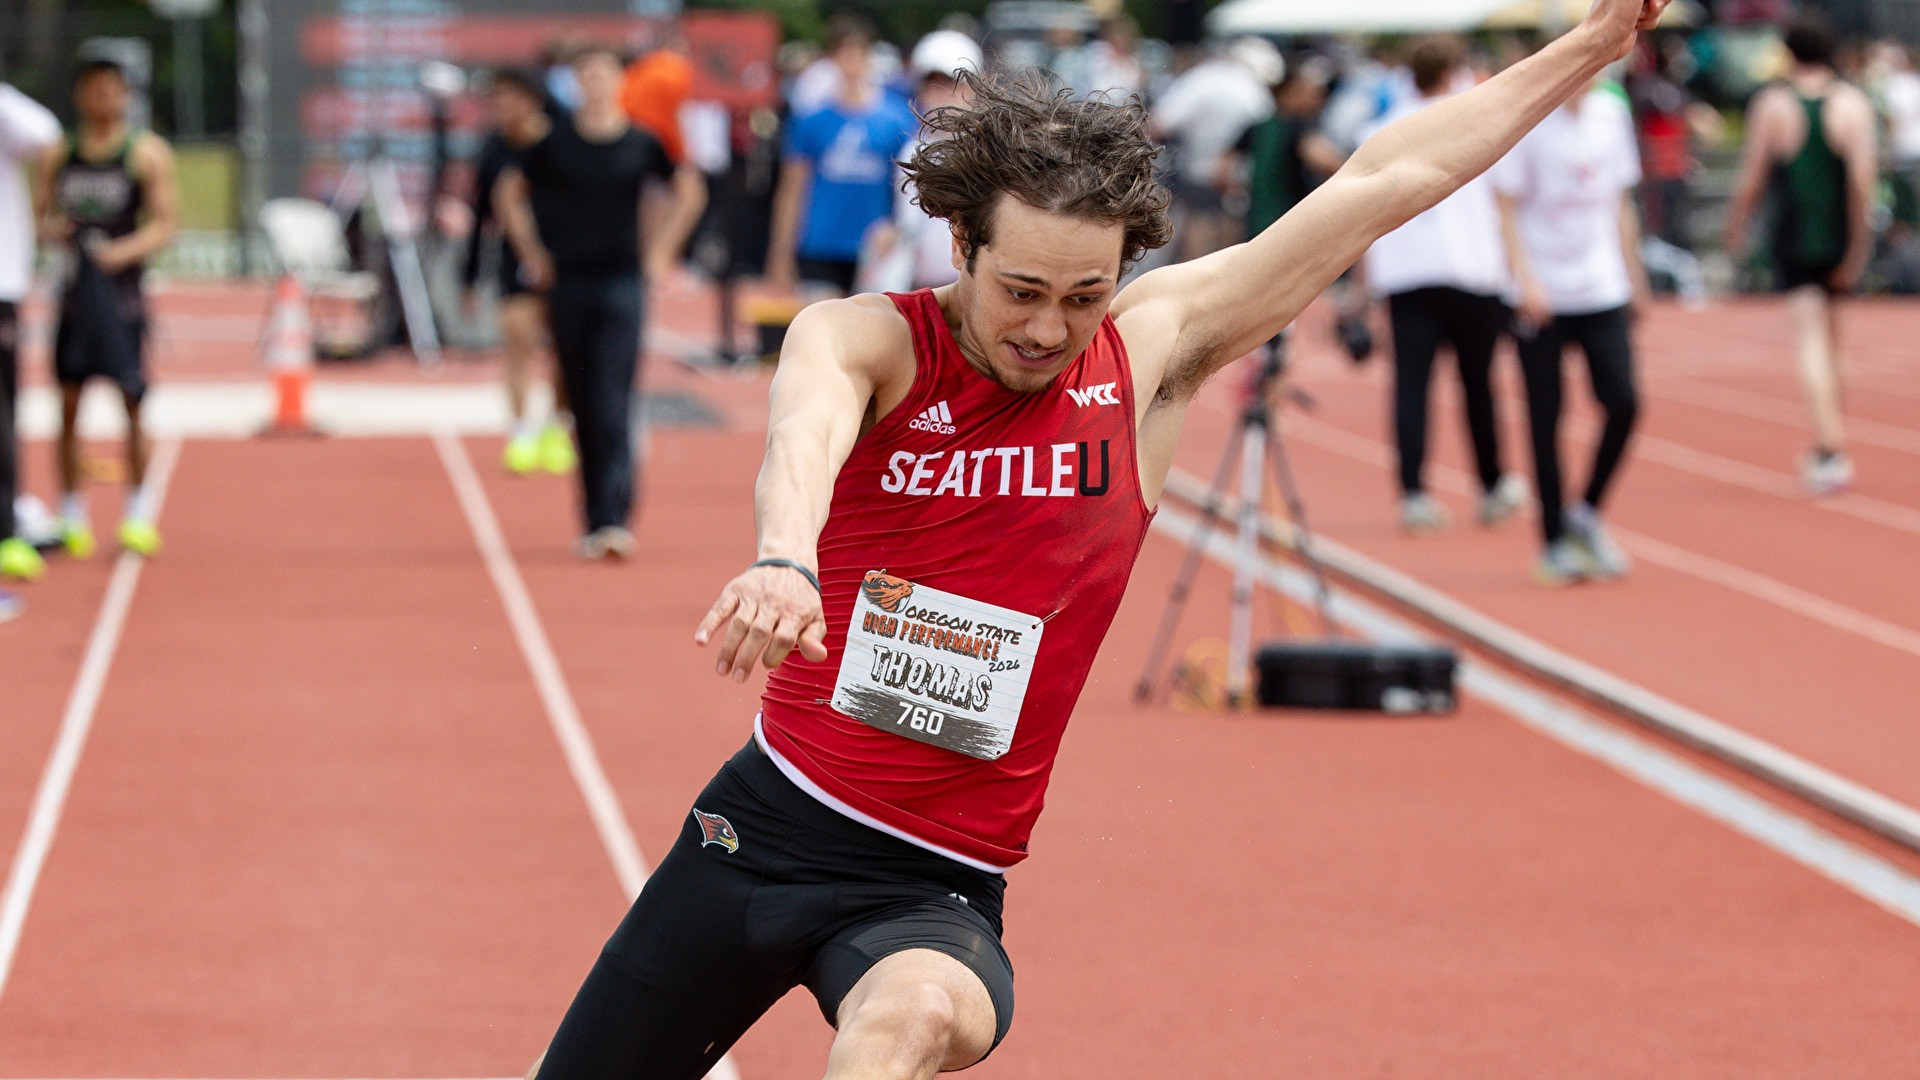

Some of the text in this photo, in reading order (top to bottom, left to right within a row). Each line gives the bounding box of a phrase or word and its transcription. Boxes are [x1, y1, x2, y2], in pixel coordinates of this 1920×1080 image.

[1066, 381, 1120, 408] WCC
[908, 417, 956, 435] adidas
[862, 611, 1001, 661] HIGH PERFORMANCE
[905, 606, 1022, 645] OREGON STATE
[871, 644, 992, 712] THOMAS
[988, 660, 1020, 673] 2026
[896, 702, 945, 735] 760
